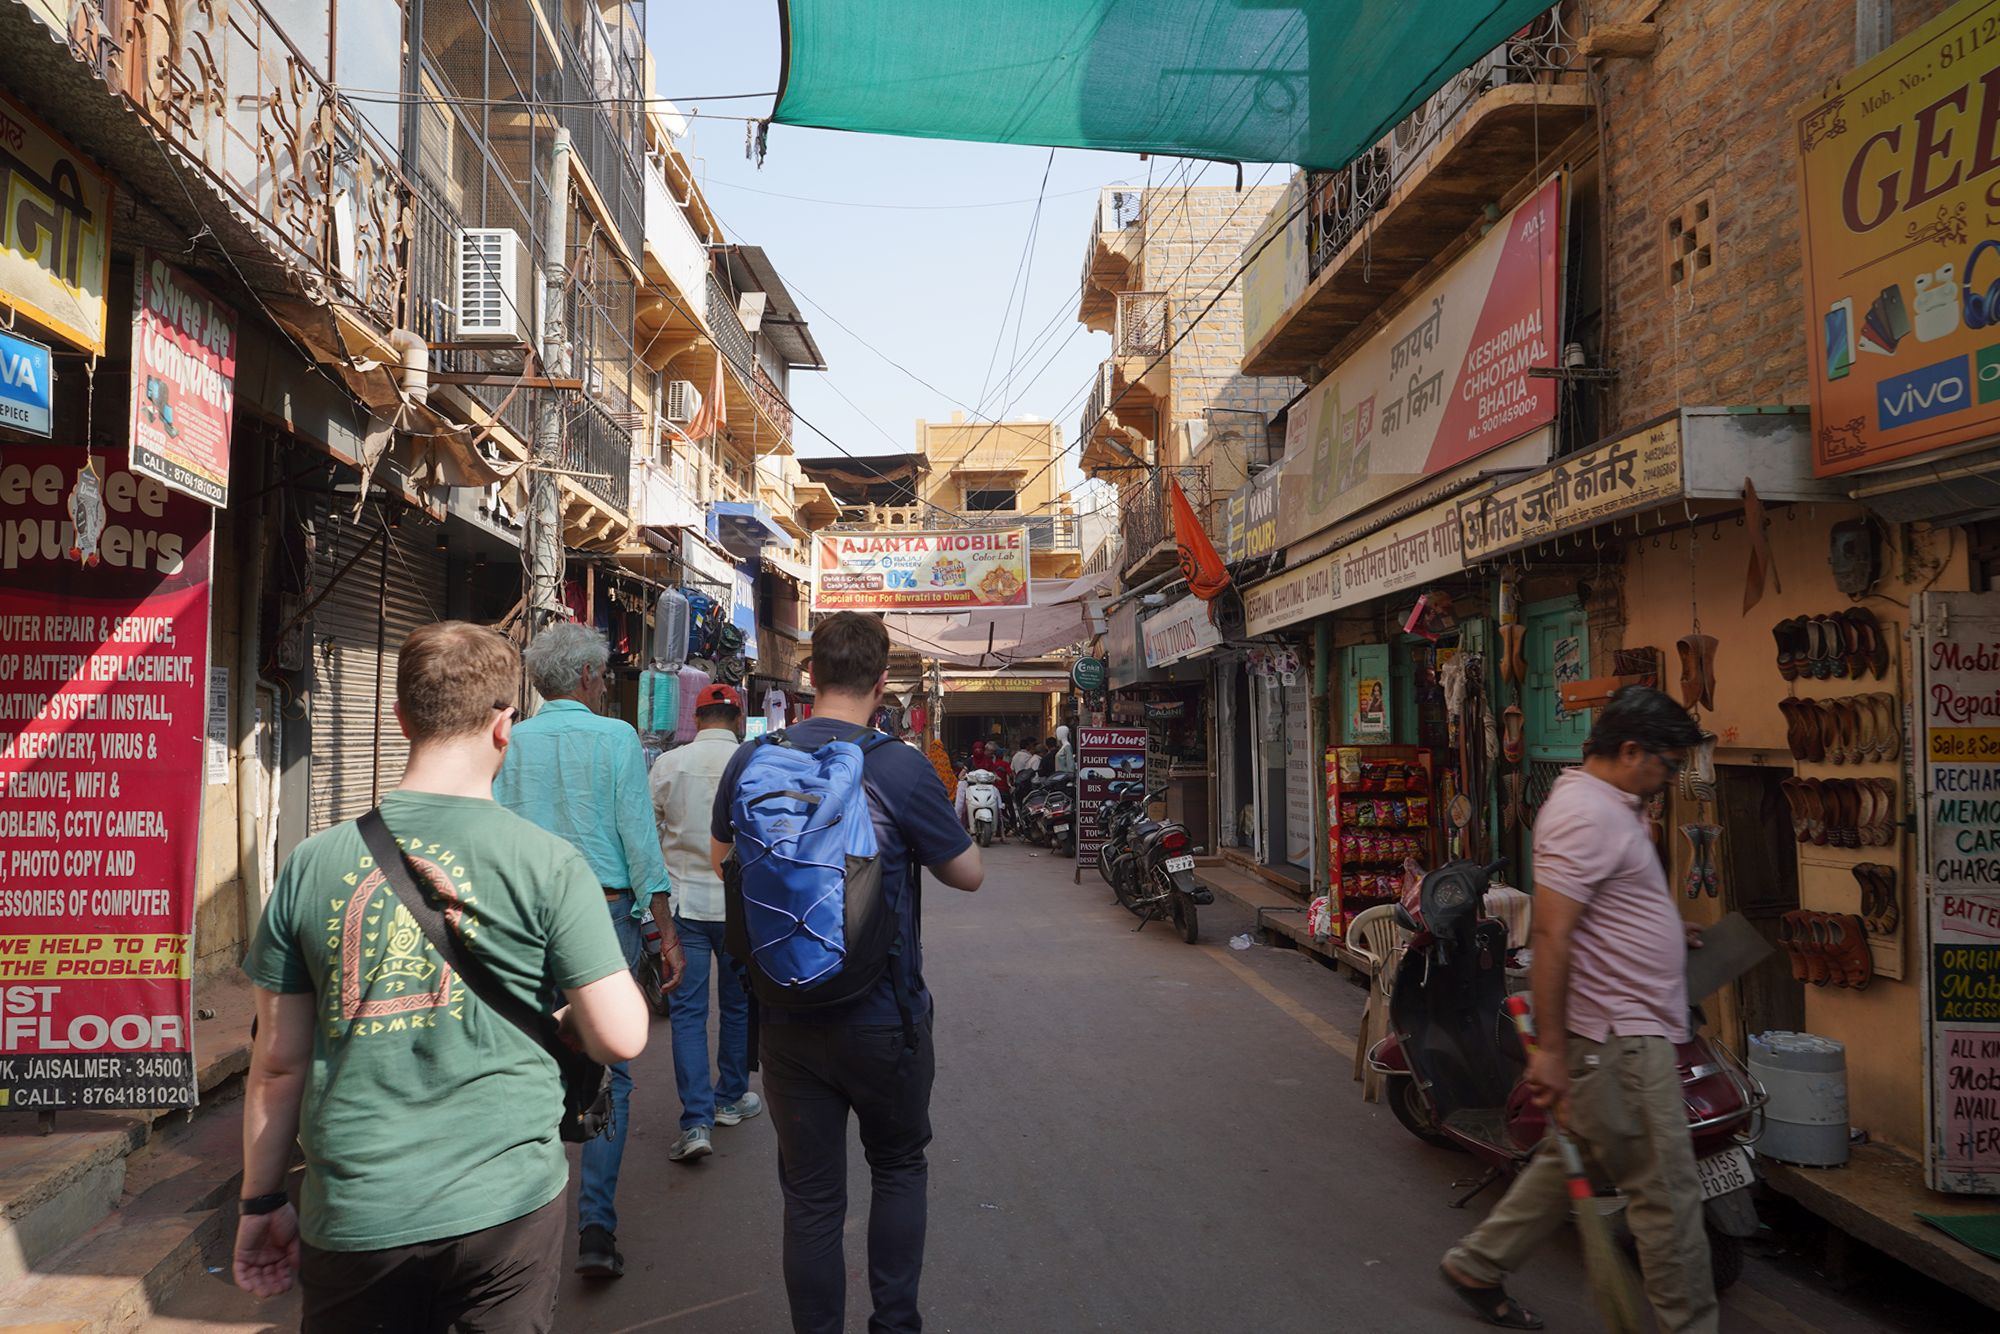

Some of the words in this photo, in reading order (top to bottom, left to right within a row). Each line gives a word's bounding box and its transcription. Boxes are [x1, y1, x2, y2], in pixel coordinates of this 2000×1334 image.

[1861, 89, 1895, 118] Mob.
[1940, 14, 2000, 70] 8112
[151, 259, 201, 340] Shree
[203, 300, 230, 358] Jee
[1468, 308, 1543, 374] KESHRIMAL
[144, 314, 232, 414] Computers
[1463, 340, 1548, 401] CHHOTAMAL
[1478, 375, 1527, 420] BHATIA
[1884, 377, 1963, 416] vivo
[1382, 397, 1404, 437] का
[1482, 395, 1538, 435] 9001459009
[143, 453, 167, 476] CALL
[1250, 486, 1272, 523] YAVI
[1246, 518, 1277, 557] TOURS
[1462, 494, 1518, 550] अनिल
[3, 518, 184, 576] puers
[842, 537, 929, 554] AJANTA
[936, 534, 1020, 551] MOBILE
[972, 552, 996, 563] Color
[998, 551, 1015, 562] Lab
[887, 569, 918, 589] 0%
[821, 594, 853, 604] Special
[855, 593, 877, 603] Offer
[879, 593, 892, 602] For
[895, 592, 930, 602] Navratri
[934, 593, 942, 601] to
[943, 592, 970, 601] Diwali
[0, 616, 41, 641] UTER
[45, 616, 95, 641] REPAIR
[99, 617, 108, 641] &
[113, 617, 176, 649] SERVICE,
[1167, 616, 1197, 654] TOURS
[24, 655, 87, 681] BATTERY
[91, 656, 194, 688] REPLACEMENT,
[51, 694, 107, 720] SYSTEM
[112, 694, 173, 726] INSTALL,
[19, 733, 96, 764] RECOVERY,
[101, 733, 143, 759] VIRUS
[147, 734, 157, 759] &
[1081, 732, 1109, 747] Yavi
[1110, 732, 1146, 746] Tours
[1933, 734, 1964, 755] Sale
[1966, 736, 1978, 755] &
[1083, 755, 1108, 764] FLIGHT
[9, 772, 71, 803] REMOVE,
[76, 772, 105, 798] WIFI
[109, 772, 120, 797] &
[1087, 784, 1102, 793] BUS
[64, 811, 103, 838] CCTV
[106, 811, 168, 843] CAMERA,
[1080, 816, 1094, 824] CAR
[1080, 843, 1103, 852] PASSP
[11, 850, 60, 877] PHOTO
[63, 850, 103, 877] COPY
[105, 851, 136, 877] AND
[69, 890, 88, 916] OF
[91, 889, 170, 916] COMPUTER
[1944, 895, 2000, 929] BATTE
[40, 938, 103, 955] HELP
[113, 938, 145, 954] TO
[154, 938, 188, 954] FIX
[2, 960, 46, 976] THE
[56, 959, 180, 976] PROBLEM!
[381, 959, 426, 974] INCE
[385, 981, 406, 994] 73
[1950, 1039, 1976, 1060] ALL
[24, 1058, 121, 1080] JAISALMER
[15, 1089, 65, 1105] CALL
[83, 1087, 189, 1105] 8764181020
